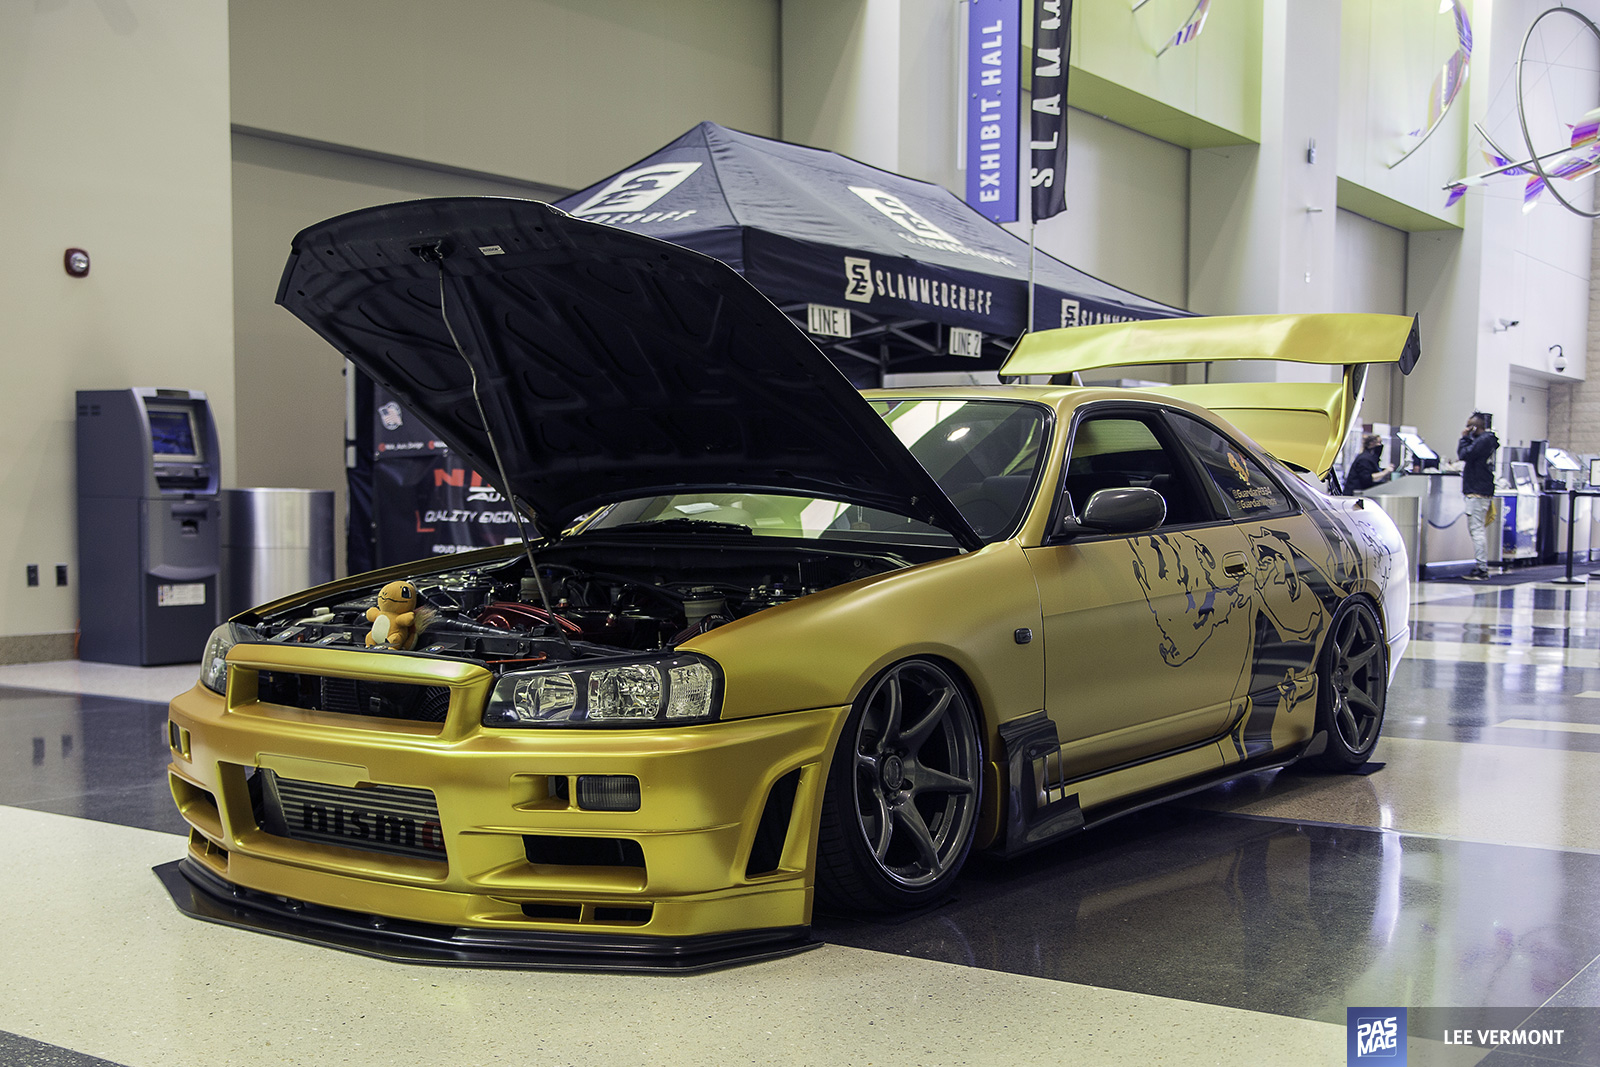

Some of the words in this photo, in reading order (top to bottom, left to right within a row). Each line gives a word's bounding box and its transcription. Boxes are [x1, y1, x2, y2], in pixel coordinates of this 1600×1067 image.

[981, 20, 1002, 86] HALL
[980, 99, 1001, 202] EXHIBIT
[811, 307, 839, 334] LINE
[843, 310, 848, 336] 1
[952, 331, 971, 355] LINE
[973, 333, 980, 356] 2
